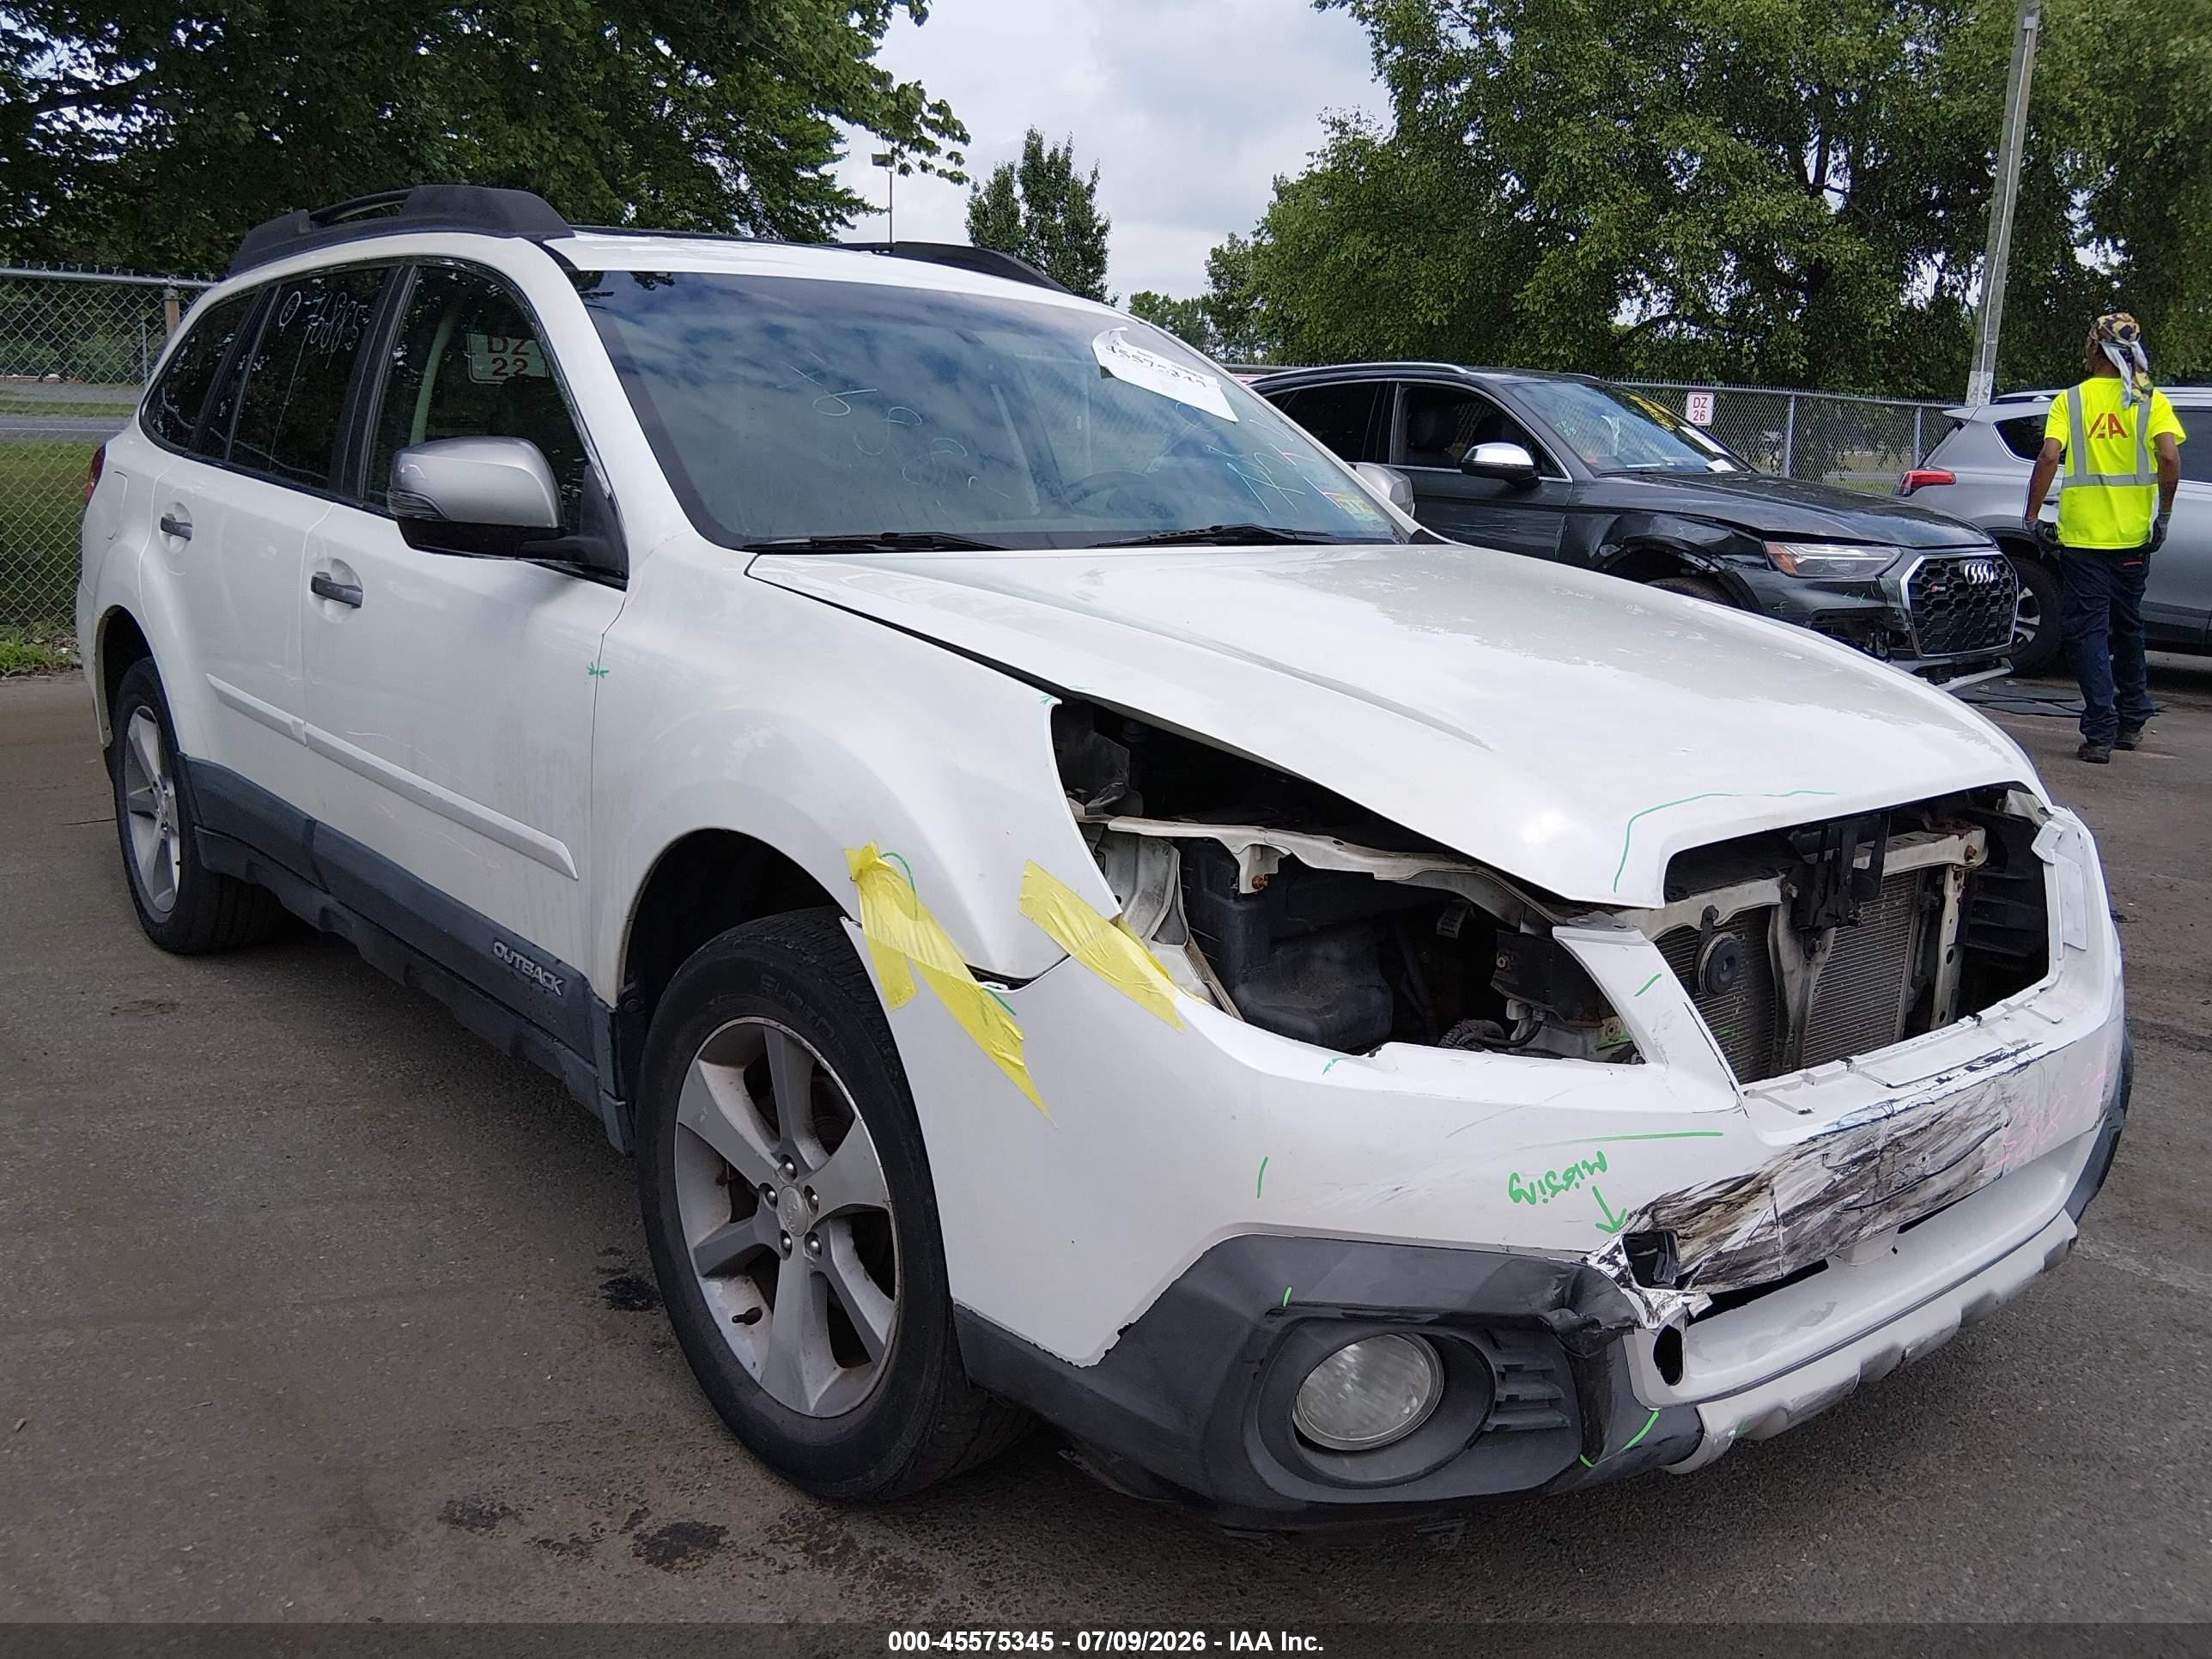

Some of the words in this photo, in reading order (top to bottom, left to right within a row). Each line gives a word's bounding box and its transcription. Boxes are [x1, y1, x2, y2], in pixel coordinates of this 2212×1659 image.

[487, 335, 530, 355] DZ
[492, 357, 528, 377] 22
[1692, 397, 1708, 409] DZ
[1692, 410, 1705, 422] 26
[493, 941, 564, 996] OUTBACK
